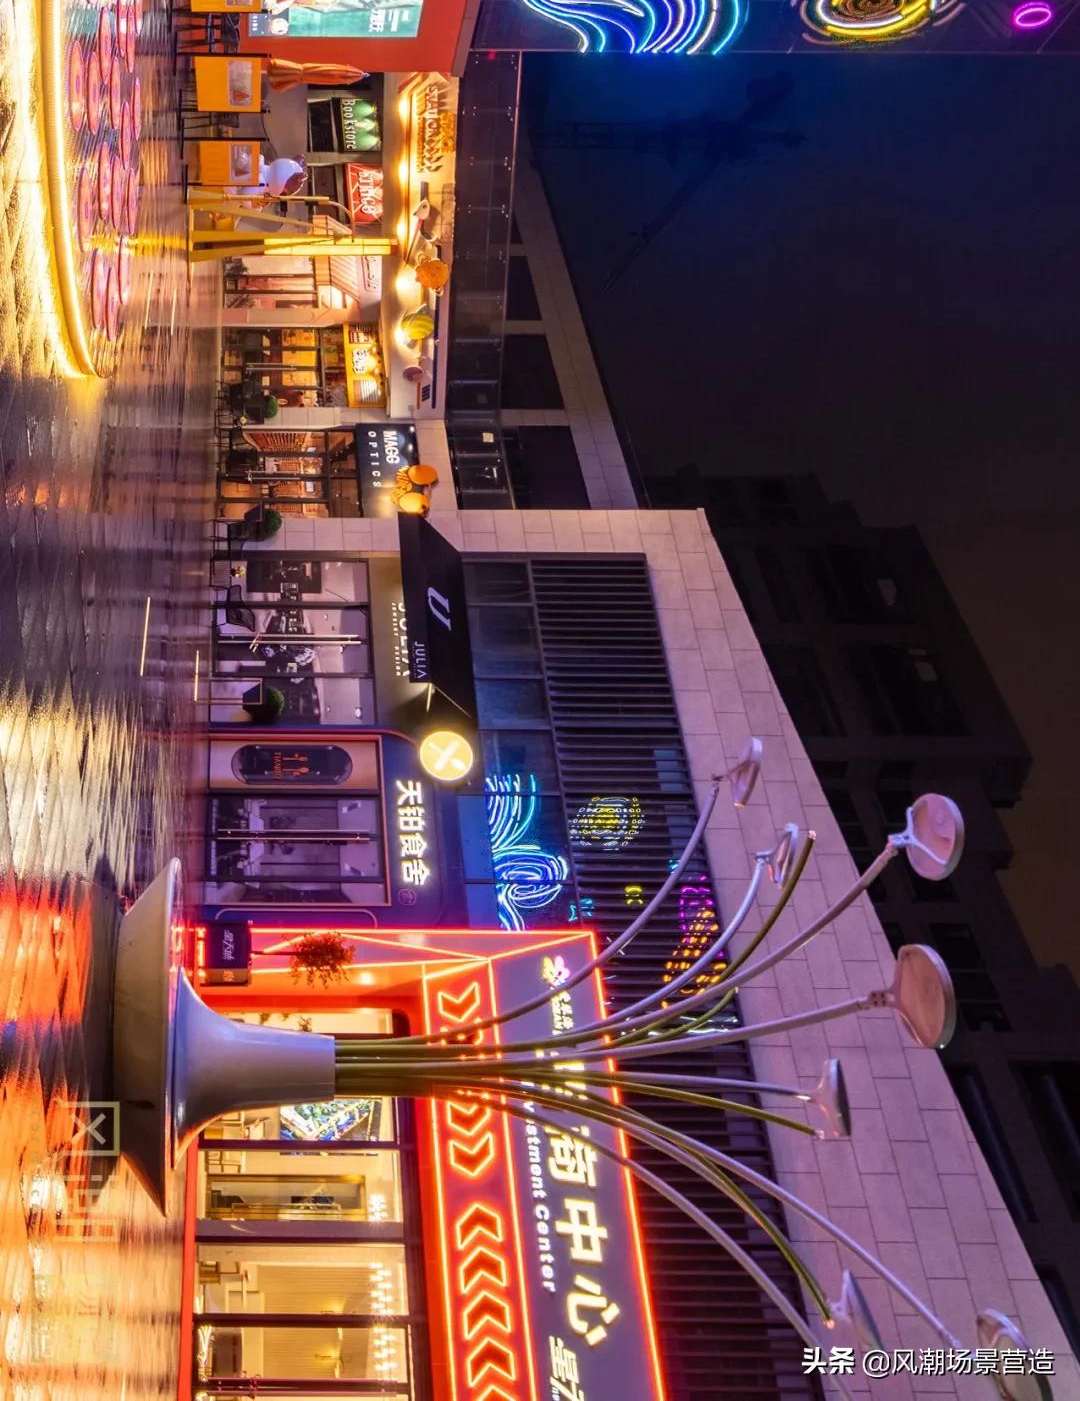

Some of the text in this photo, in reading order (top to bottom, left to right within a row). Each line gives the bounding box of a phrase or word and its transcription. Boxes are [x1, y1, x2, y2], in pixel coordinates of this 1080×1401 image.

[342, 99, 358, 150] Bookstore
[368, 431, 381, 487] OPTICS
[383, 430, 400, 464] MAGG
[414, 641, 427, 679] JULIA
[395, 779, 430, 886] 天铂食舍
[520, 1081, 557, 1292] Ivstment Center
